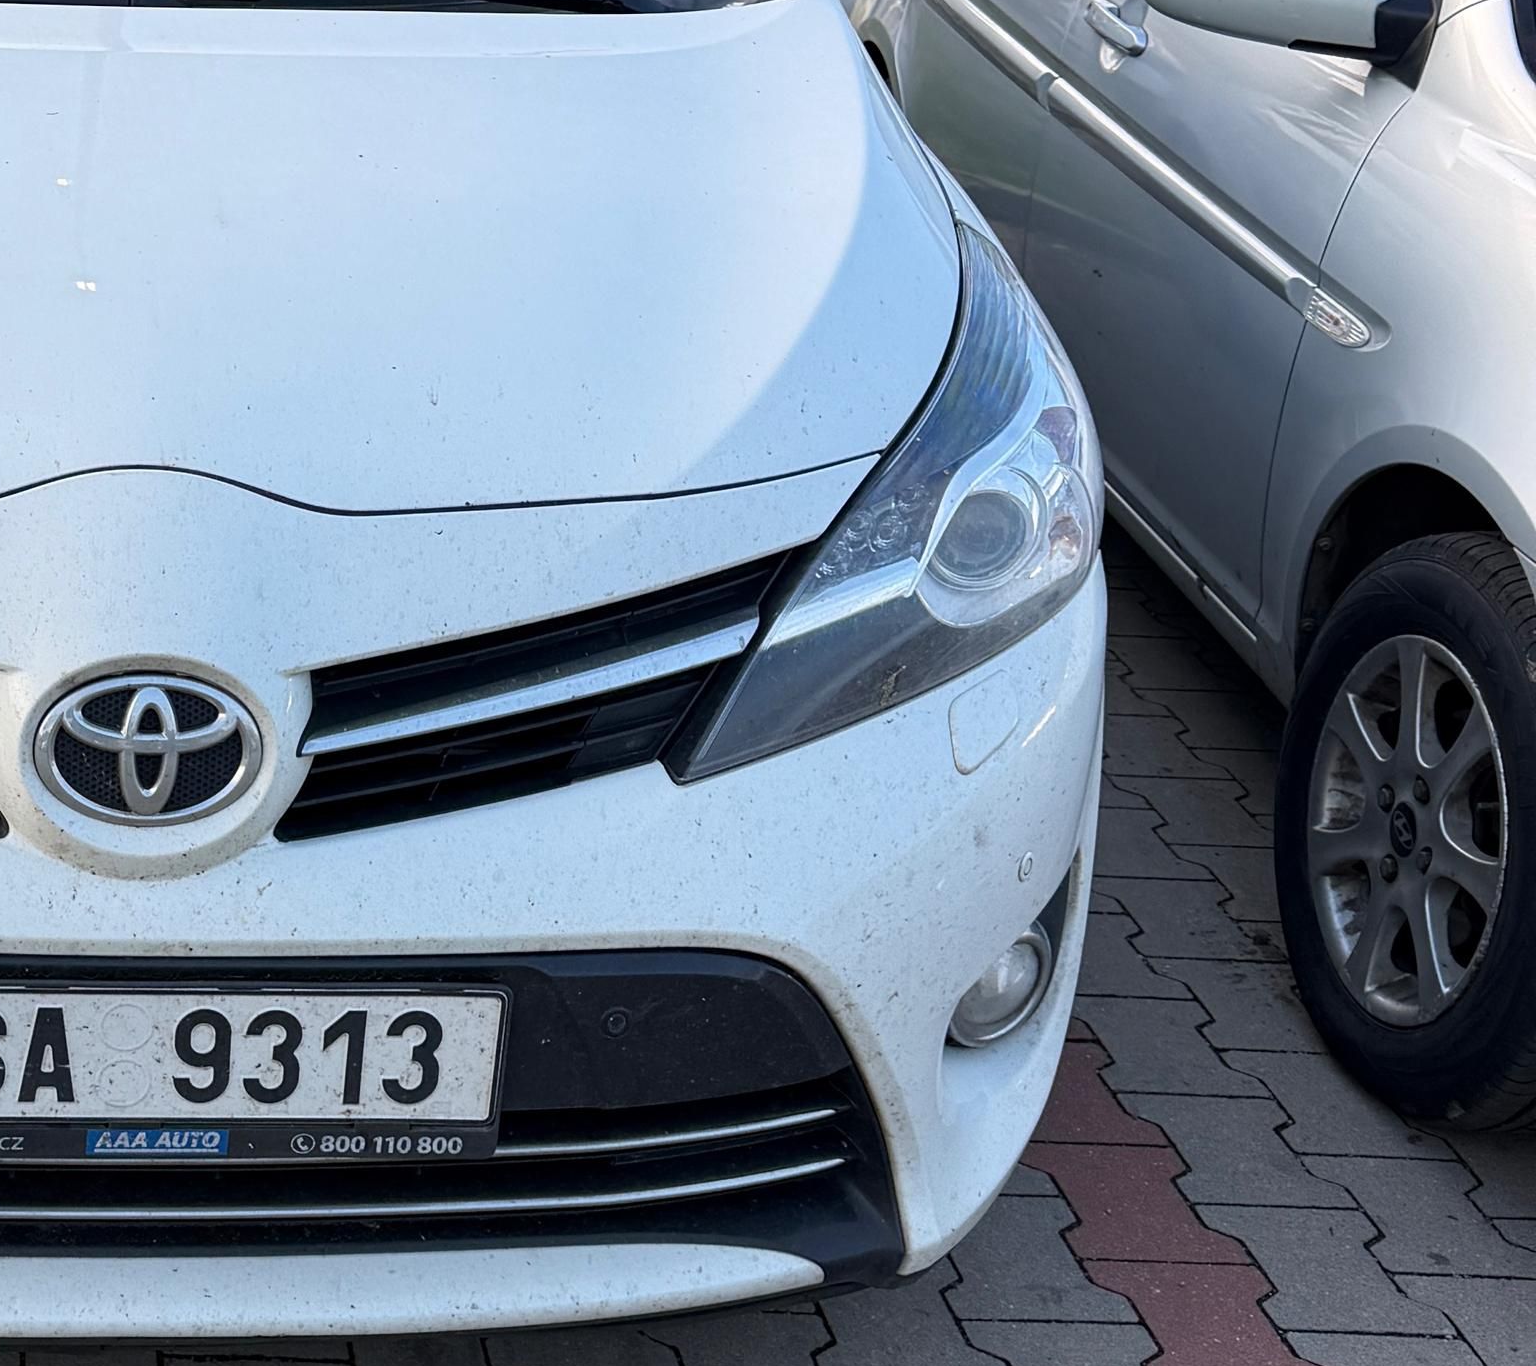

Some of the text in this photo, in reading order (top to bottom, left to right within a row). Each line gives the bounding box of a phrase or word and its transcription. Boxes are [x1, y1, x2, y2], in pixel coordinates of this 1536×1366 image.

[171, 1007, 444, 1105] 9313
[94, 1131, 221, 1148] AAA AUTO
[319, 1135, 463, 1155] 800 110 800
